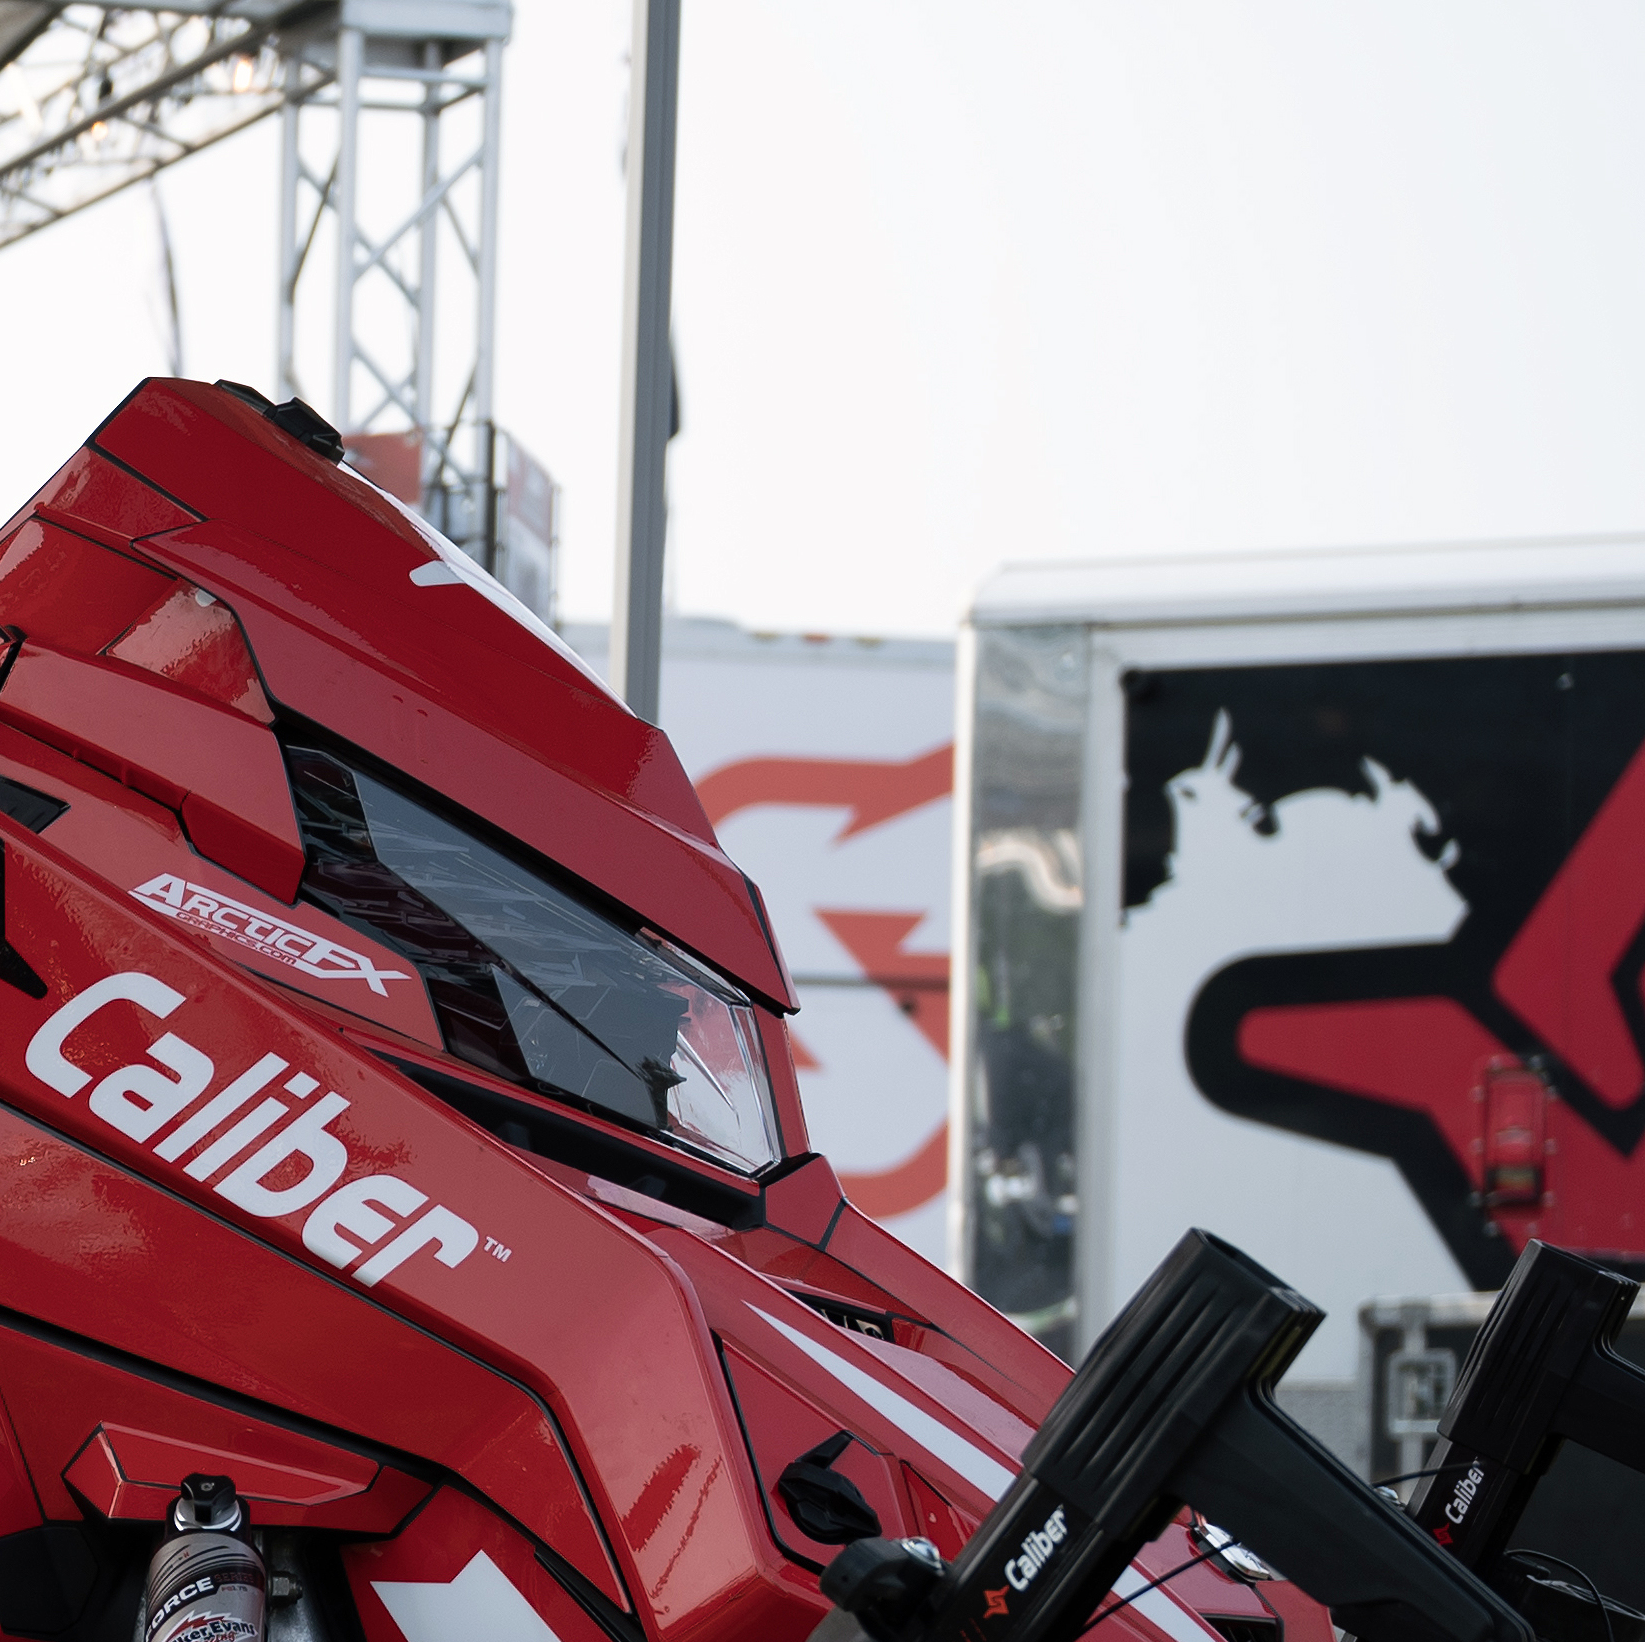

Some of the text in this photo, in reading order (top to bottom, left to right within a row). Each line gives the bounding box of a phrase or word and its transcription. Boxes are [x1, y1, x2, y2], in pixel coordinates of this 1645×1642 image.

[25, 971, 480, 1288] Caliber
[1004, 1508, 1068, 1592] Caliber
[209, 1619, 256, 1636] Evans
